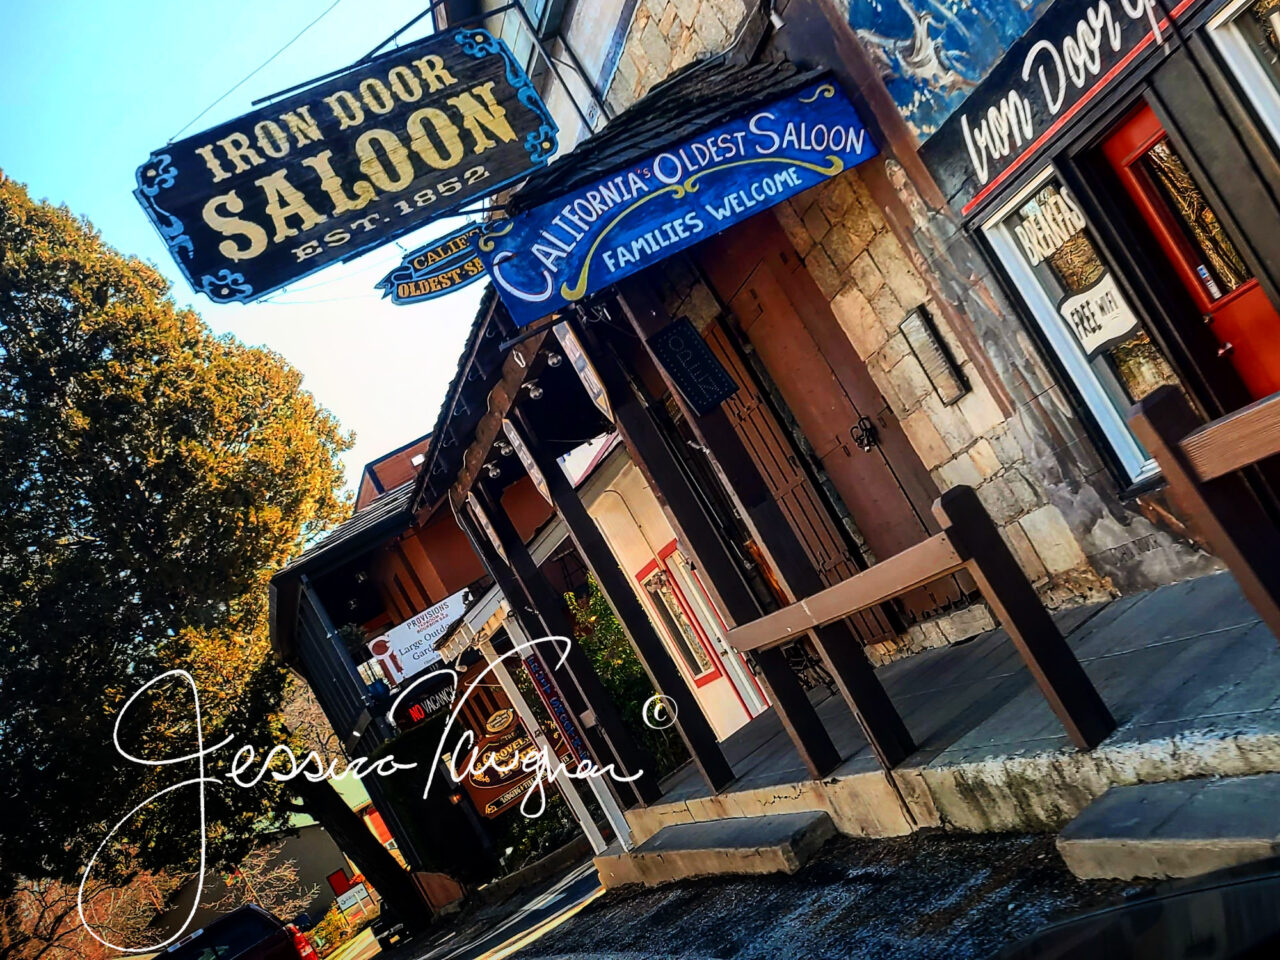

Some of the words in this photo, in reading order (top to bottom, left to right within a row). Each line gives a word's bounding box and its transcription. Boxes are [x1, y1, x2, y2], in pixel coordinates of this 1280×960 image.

[195, 103, 326, 184] IRON
[325, 53, 459, 130] DOOR
[961, 88, 1035, 186] Iron
[201, 80, 519, 264] SALOON
[653, 132, 747, 186] OLDEST
[749, 112, 865, 156] SALOON
[291, 215, 394, 264] EST.
[399, 165, 491, 218] 1852
[602, 211, 704, 273] FAMILIES
[705, 166, 803, 219] WELCOME
[397, 268, 462, 298] OLDEST
[1068, 298, 1102, 340] FREE
[406, 601, 450, 630] PROVISIONS
[398, 639, 423, 656] Large
[412, 643, 434, 661] Gard
[408, 704, 425, 722] NO
[420, 685, 455, 713] VACANCY
